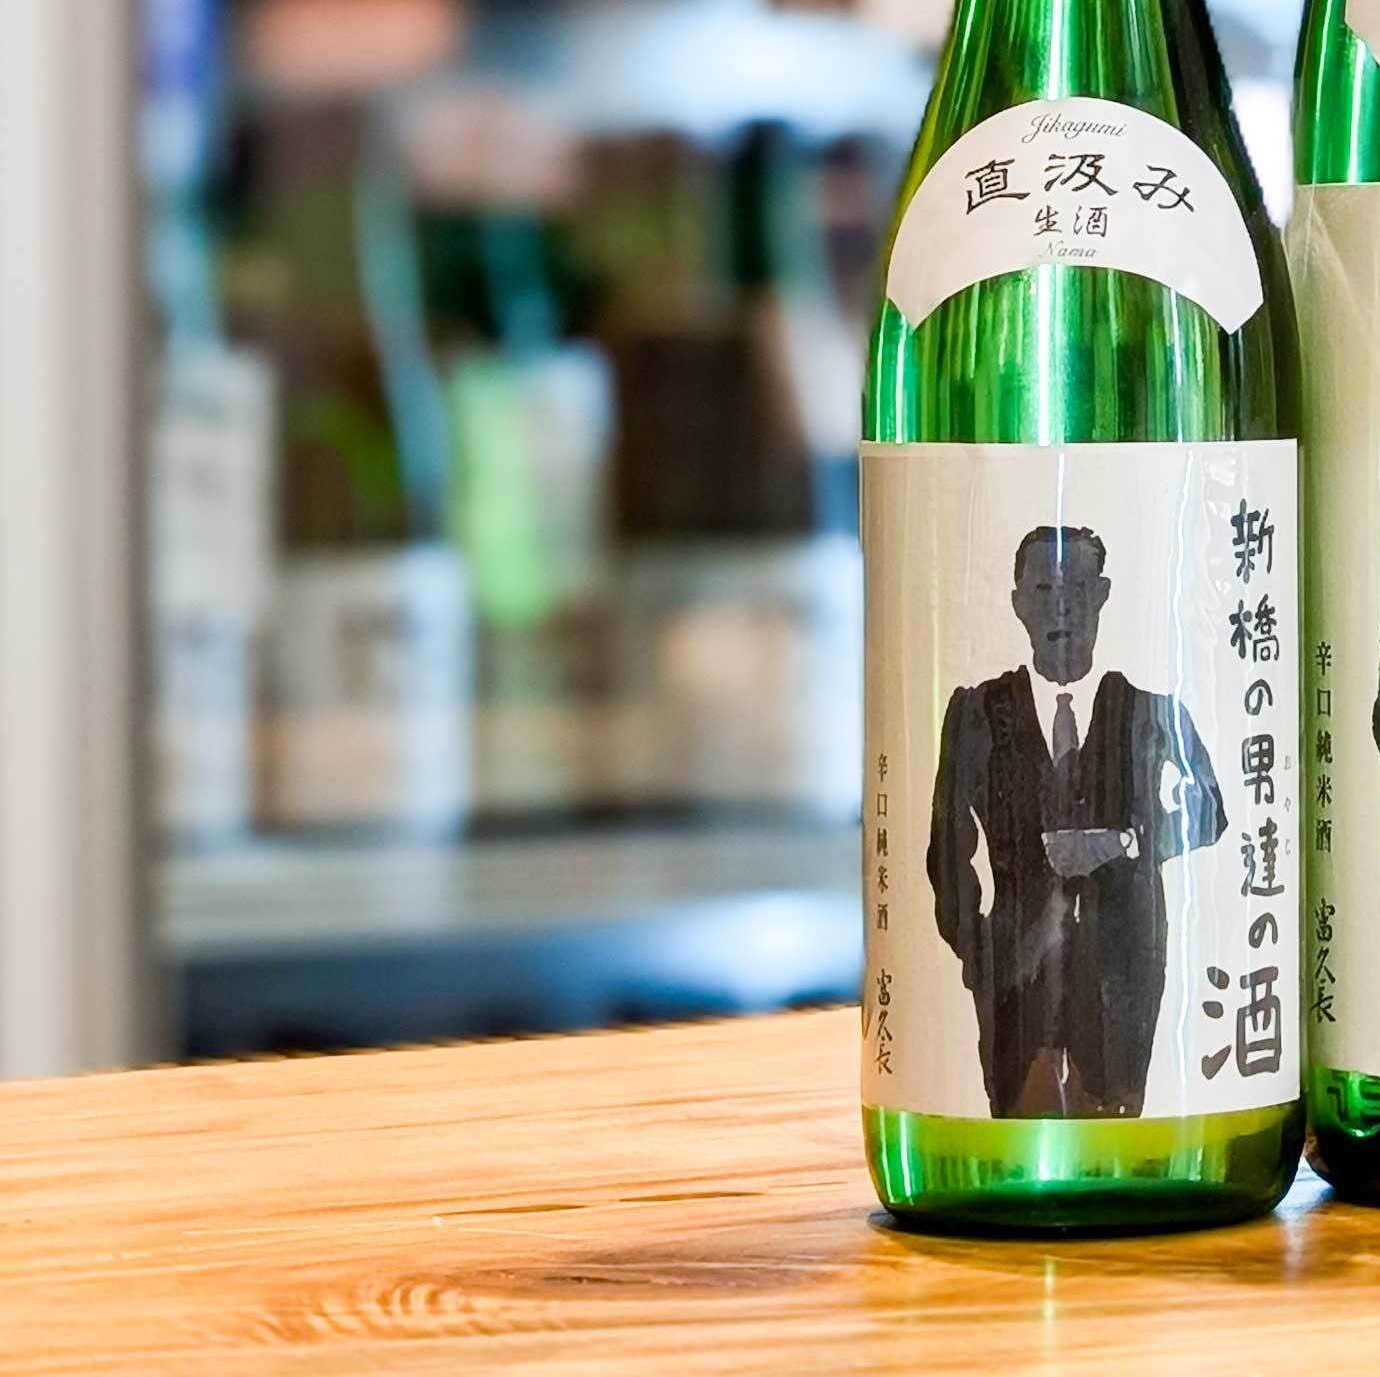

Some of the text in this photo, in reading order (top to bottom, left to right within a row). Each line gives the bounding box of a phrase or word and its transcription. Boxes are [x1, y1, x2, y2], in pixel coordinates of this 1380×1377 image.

[1021, 113, 1128, 144] Jikagumi
[965, 153, 1195, 216] 直汲み
[1032, 204, 1109, 238] 生酒
[1038, 239, 1098, 259] Nama
[1200, 498, 1286, 1082] 新橋の男達の酒
[875, 751, 890, 932] 辛口純米酒
[1307, 640, 1338, 1025] 辛口純米酒 富久長
